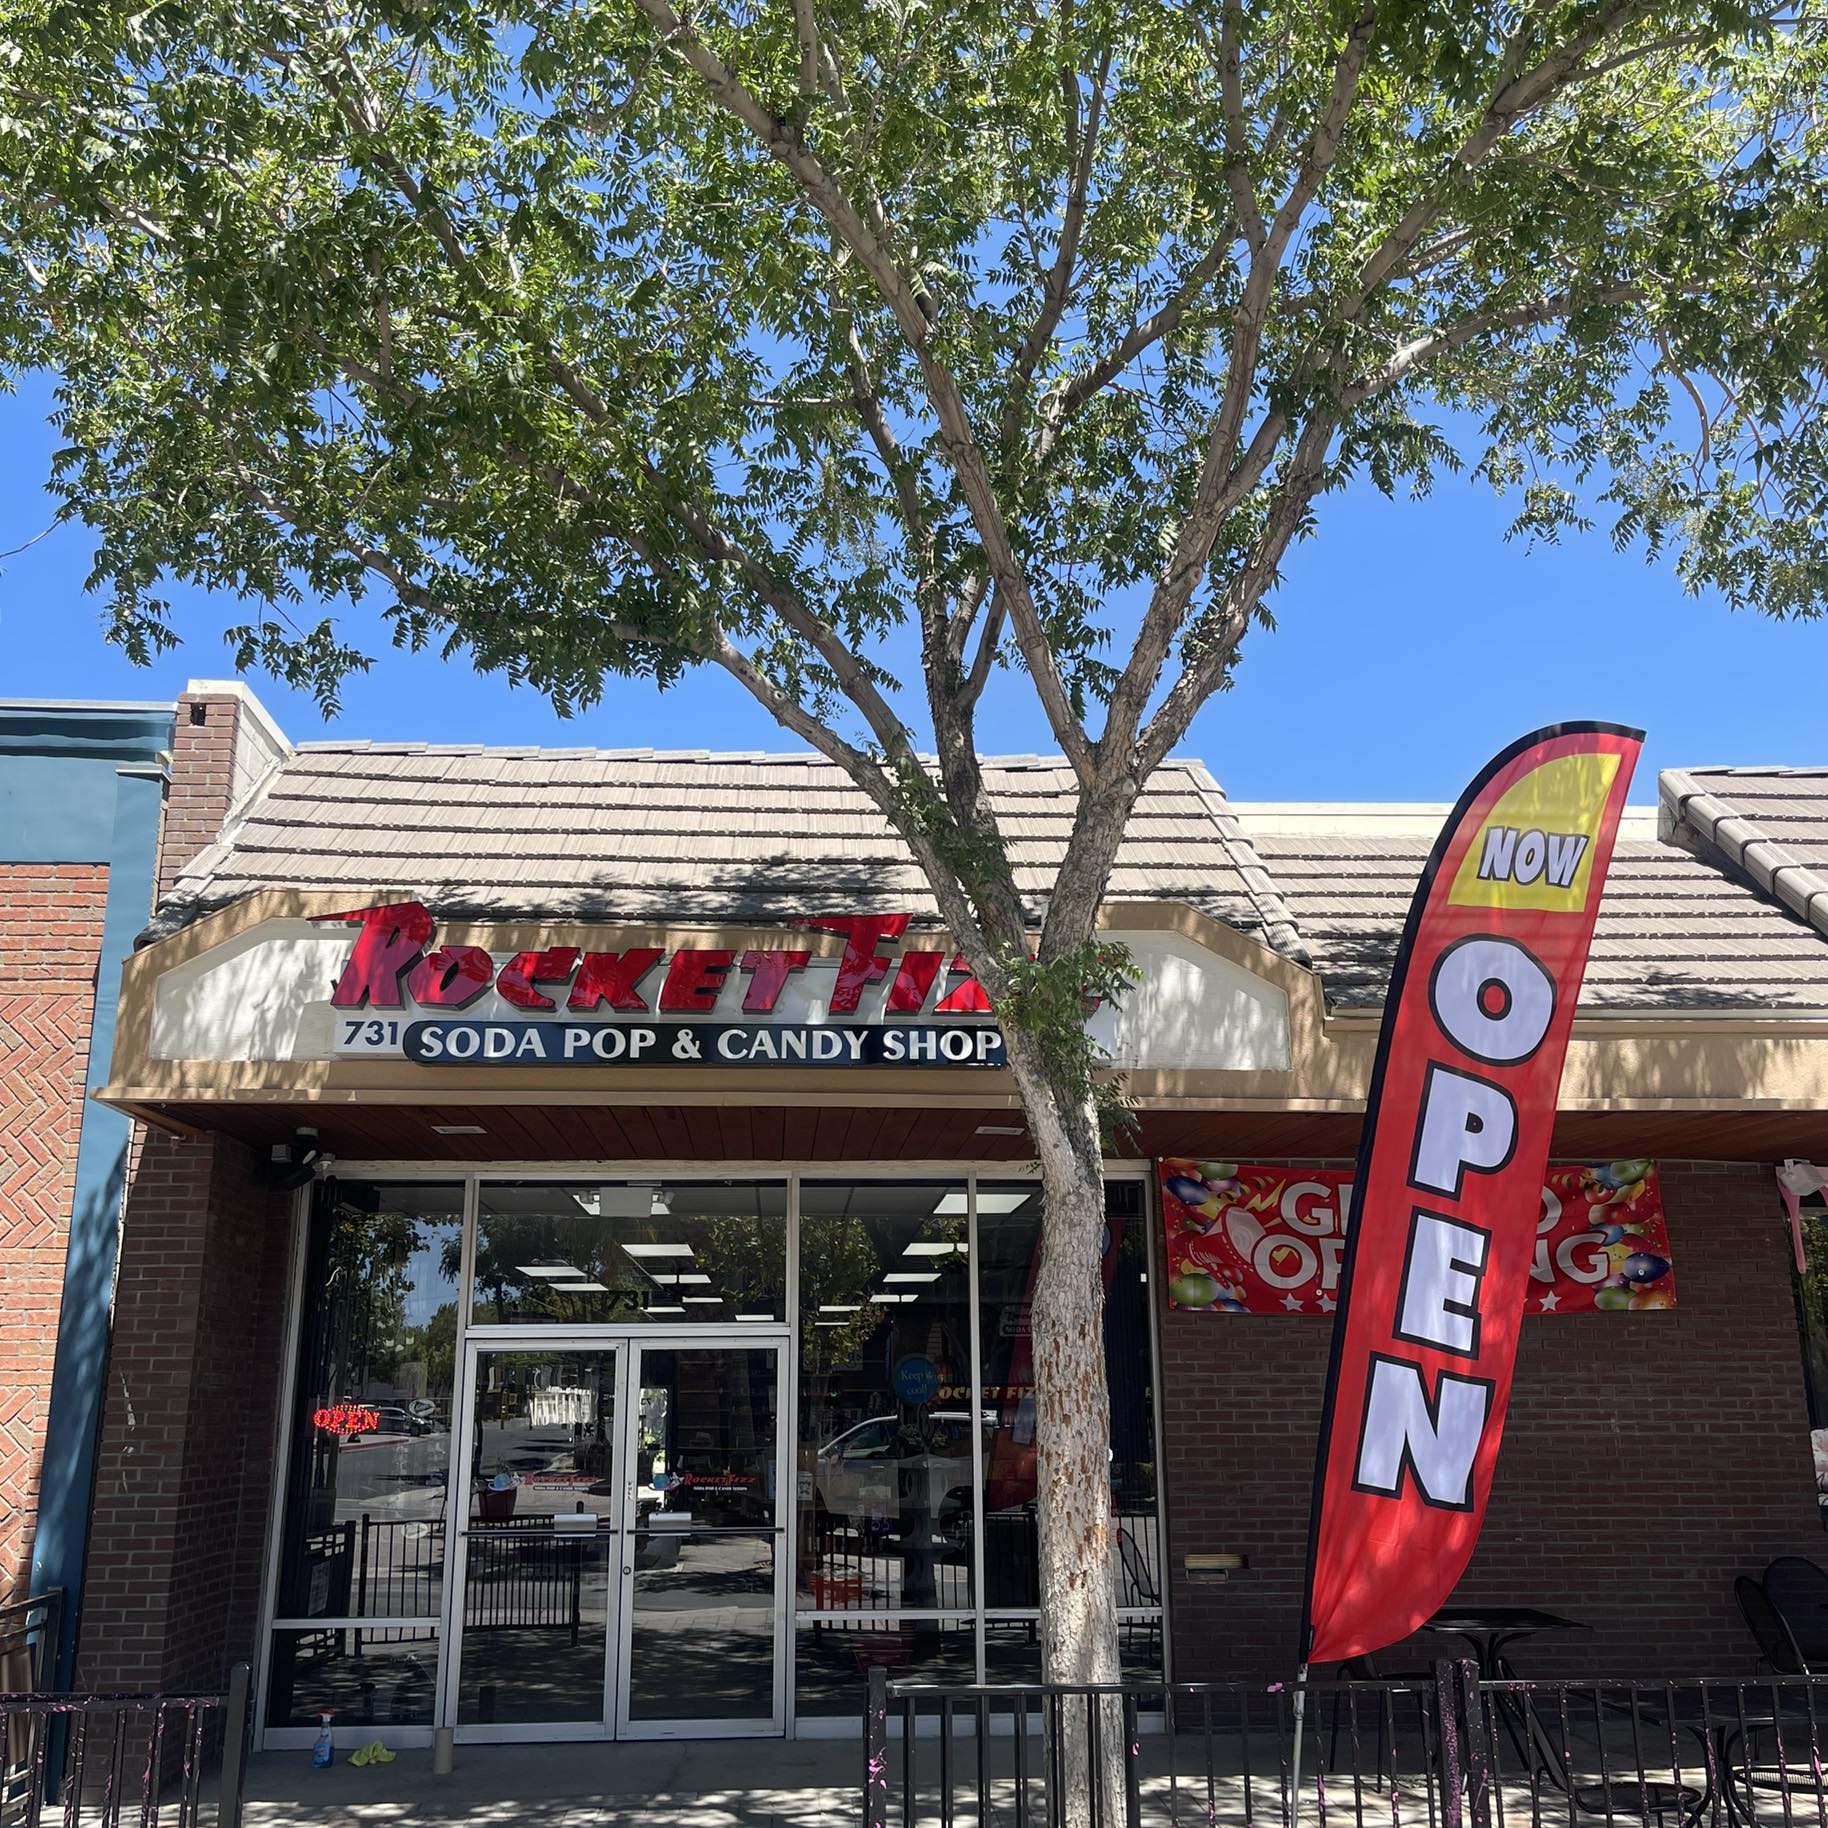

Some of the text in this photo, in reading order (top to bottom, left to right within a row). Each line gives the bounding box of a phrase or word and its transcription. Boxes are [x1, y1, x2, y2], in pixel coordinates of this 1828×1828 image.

[1477, 826, 1590, 889] NOW
[306, 901, 1101, 1018] ROCKET FIZ
[343, 1021, 398, 1046] 731
[419, 1026, 547, 1059] SODA
[563, 1028, 656, 1059] POP
[671, 1029, 702, 1059] &
[717, 1030, 868, 1060] CANDY
[1351, 933, 1556, 1514] OPEN
[313, 1408, 380, 1430] OPEN
